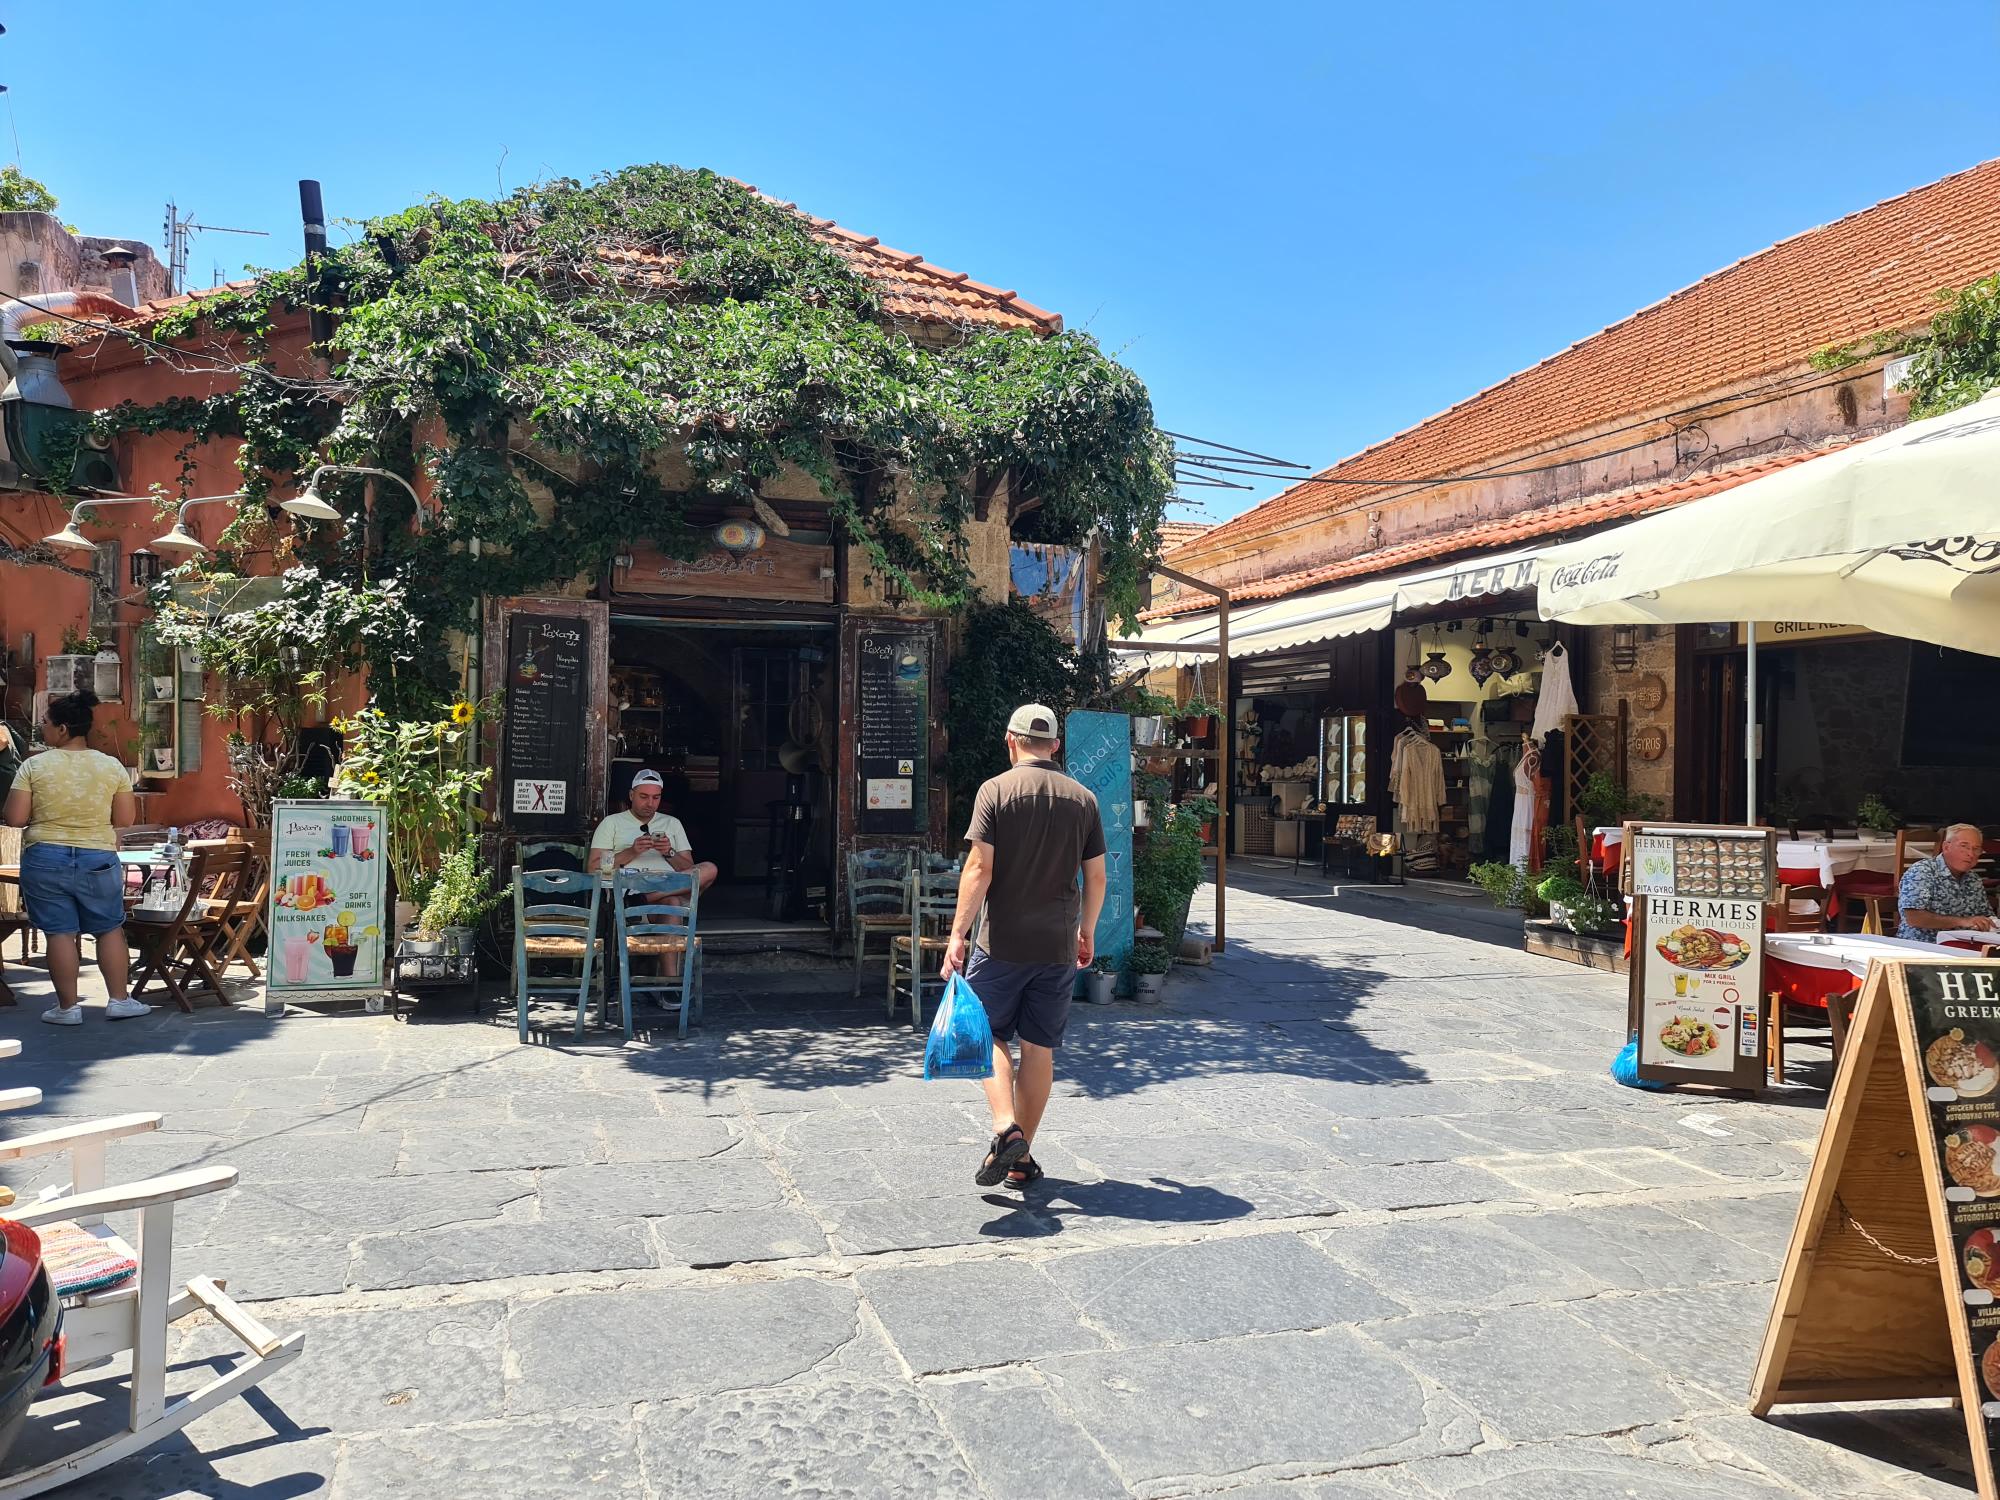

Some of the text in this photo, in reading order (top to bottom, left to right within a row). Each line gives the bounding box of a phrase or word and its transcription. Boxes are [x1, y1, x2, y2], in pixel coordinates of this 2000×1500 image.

[1551, 552, 1623, 593] Coca-Cola
[1448, 561, 1538, 599] HERM
[1774, 621, 1814, 634] GRILL
[1635, 738, 1661, 750] GYROS
[331, 815, 372, 823] SMOOTHIES
[1636, 885, 1651, 893] PITA
[345, 901, 372, 909] DRINKS
[1651, 899, 1757, 921] HERMES
[1650, 916, 1756, 930] GREEK GRILL HOUSE
[1944, 1005, 2000, 1018] GREEK
[1946, 1104, 1974, 1112] CHICKEN
[1957, 1203, 1987, 1212] CHICKEN
